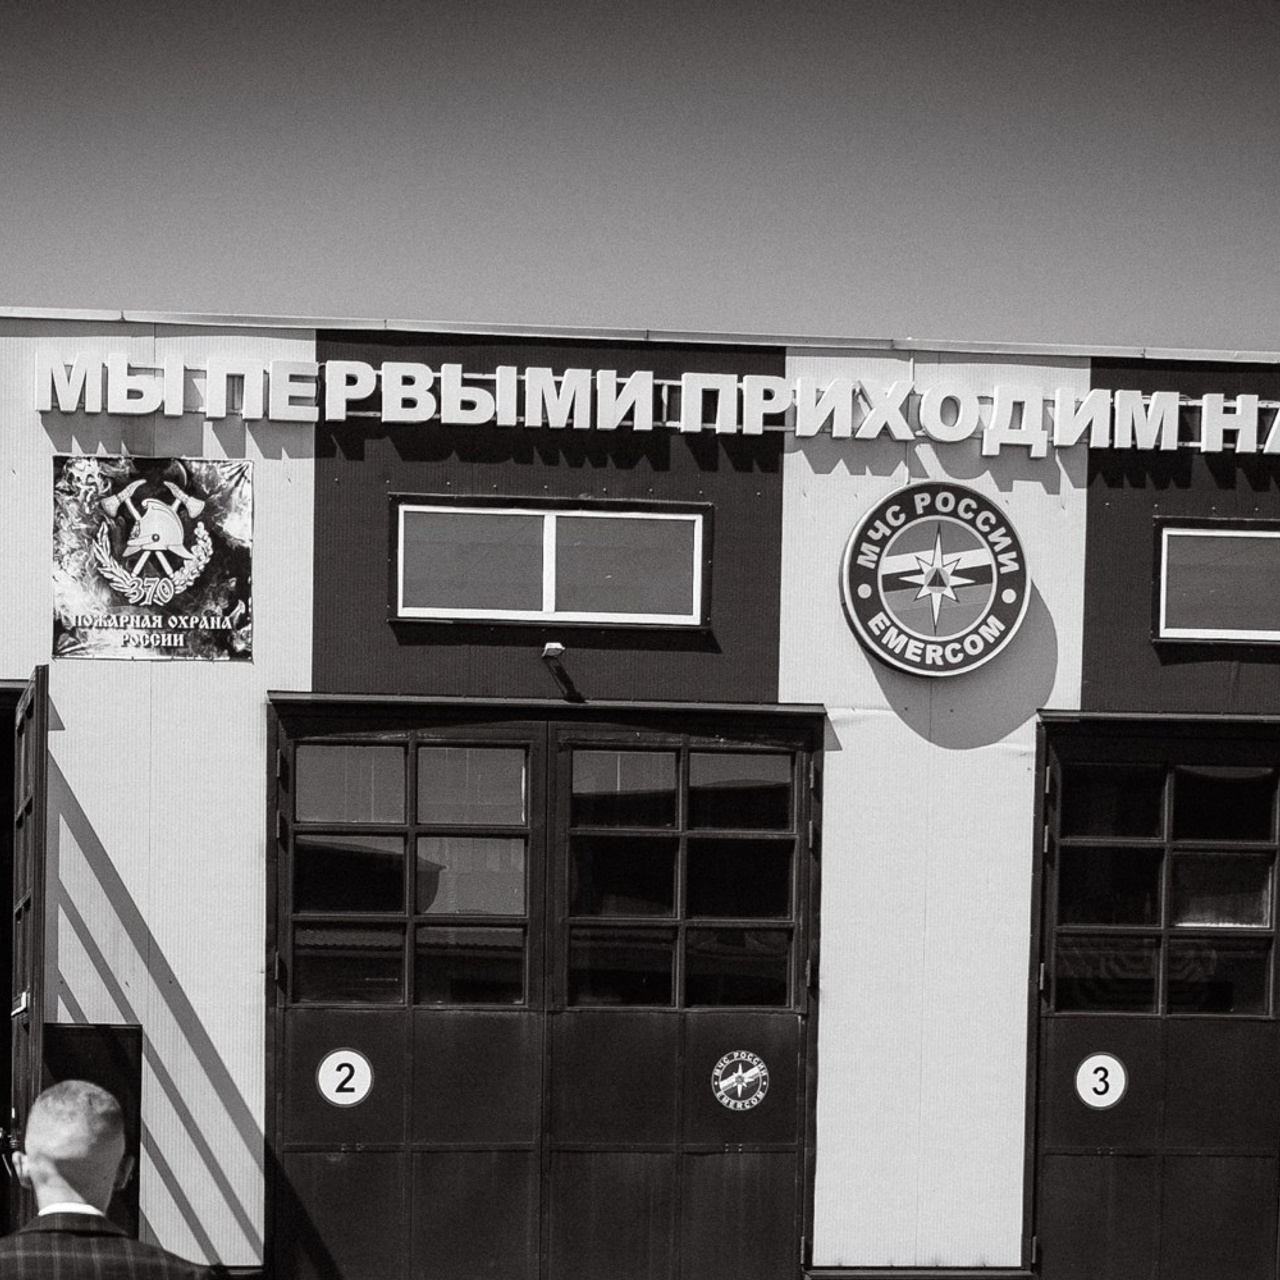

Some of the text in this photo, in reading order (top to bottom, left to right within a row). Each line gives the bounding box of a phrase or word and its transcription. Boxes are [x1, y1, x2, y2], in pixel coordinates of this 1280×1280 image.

[34, 352, 1280, 458] МЫ ПЕРВЫМИ ПРИХОДИМ Н
[856, 491, 1020, 576] МЧС РОССИИ
[126, 577, 174, 605] 370
[74, 614, 233, 630] ПОЖАРНАЯ ОХРАНА
[121, 633, 185, 648] РОССИИ
[868, 614, 1007, 667] EMERCOM
[334, 1062, 356, 1093] 2
[733, 1051, 768, 1077] РОССИИ
[1092, 1066, 1110, 1096] 3
